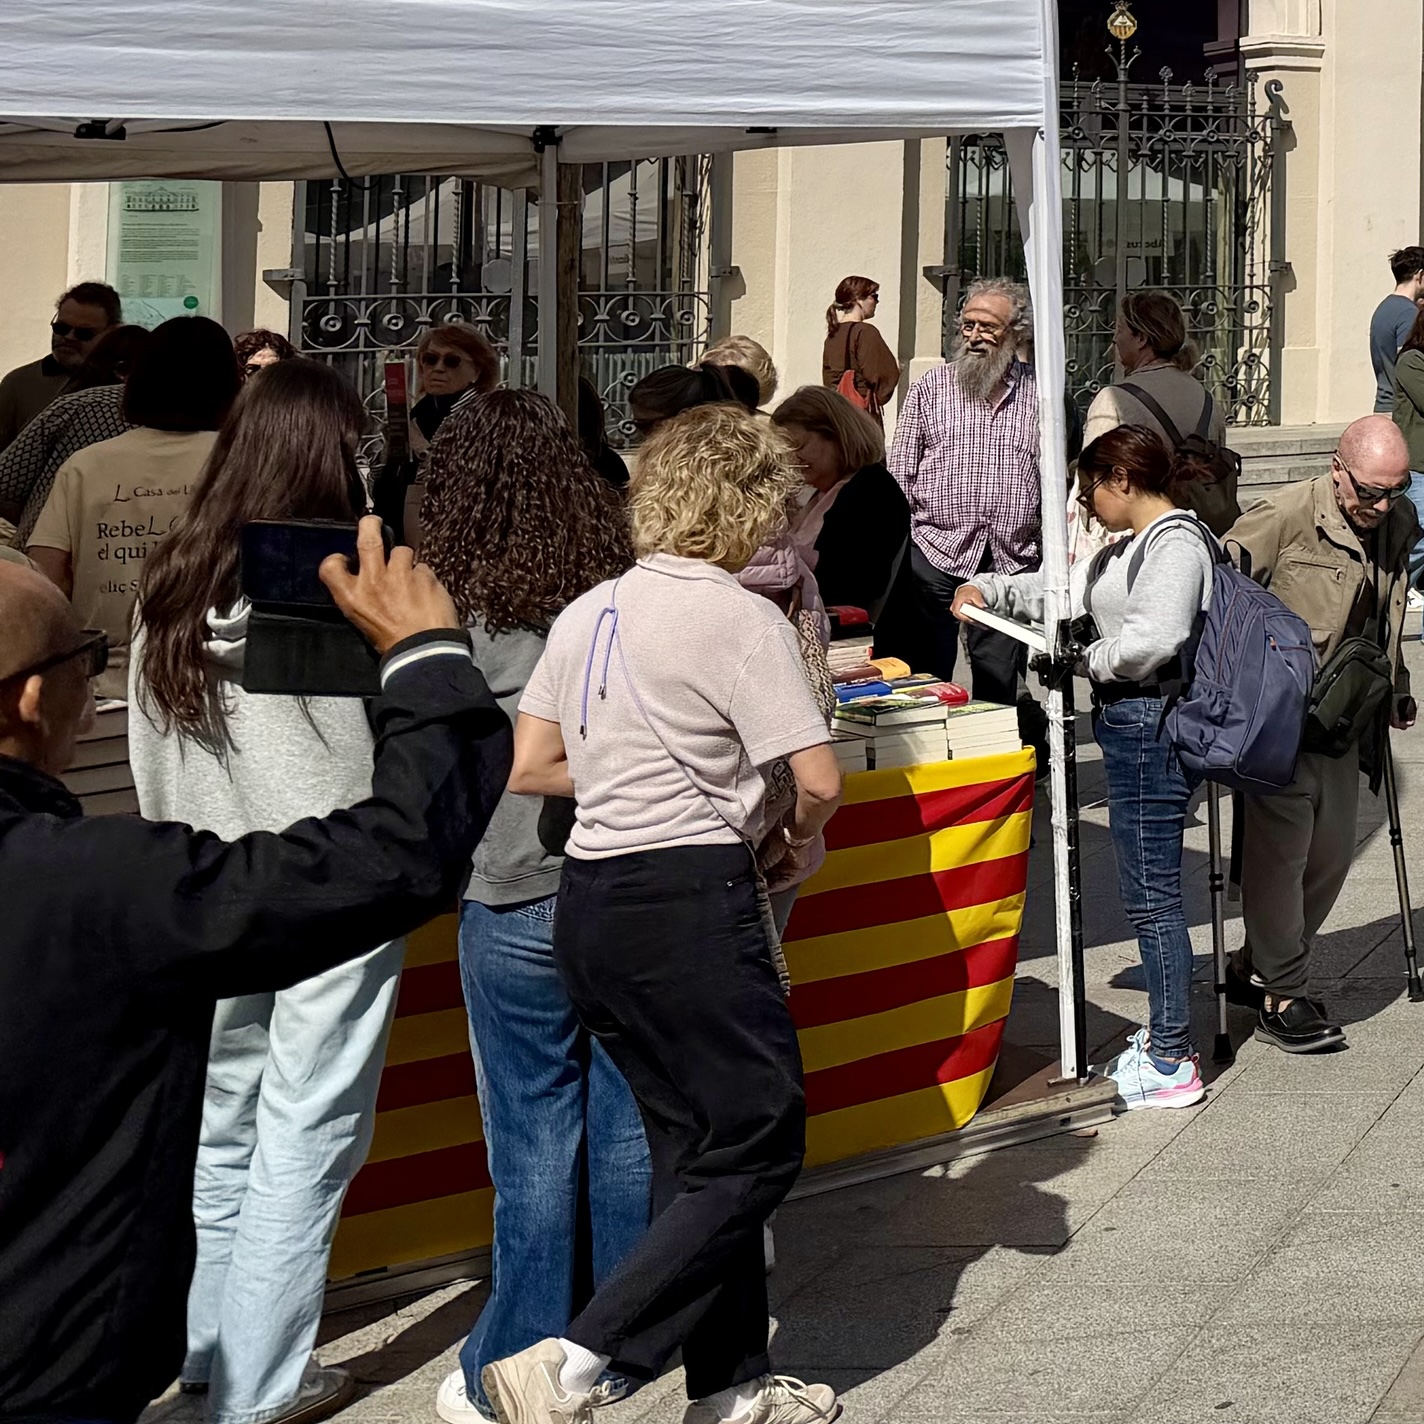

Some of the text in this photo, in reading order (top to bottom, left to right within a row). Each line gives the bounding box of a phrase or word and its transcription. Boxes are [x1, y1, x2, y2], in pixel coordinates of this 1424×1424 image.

[133, 486, 163, 498] Casa
[97, 542, 147, 565] el qui
